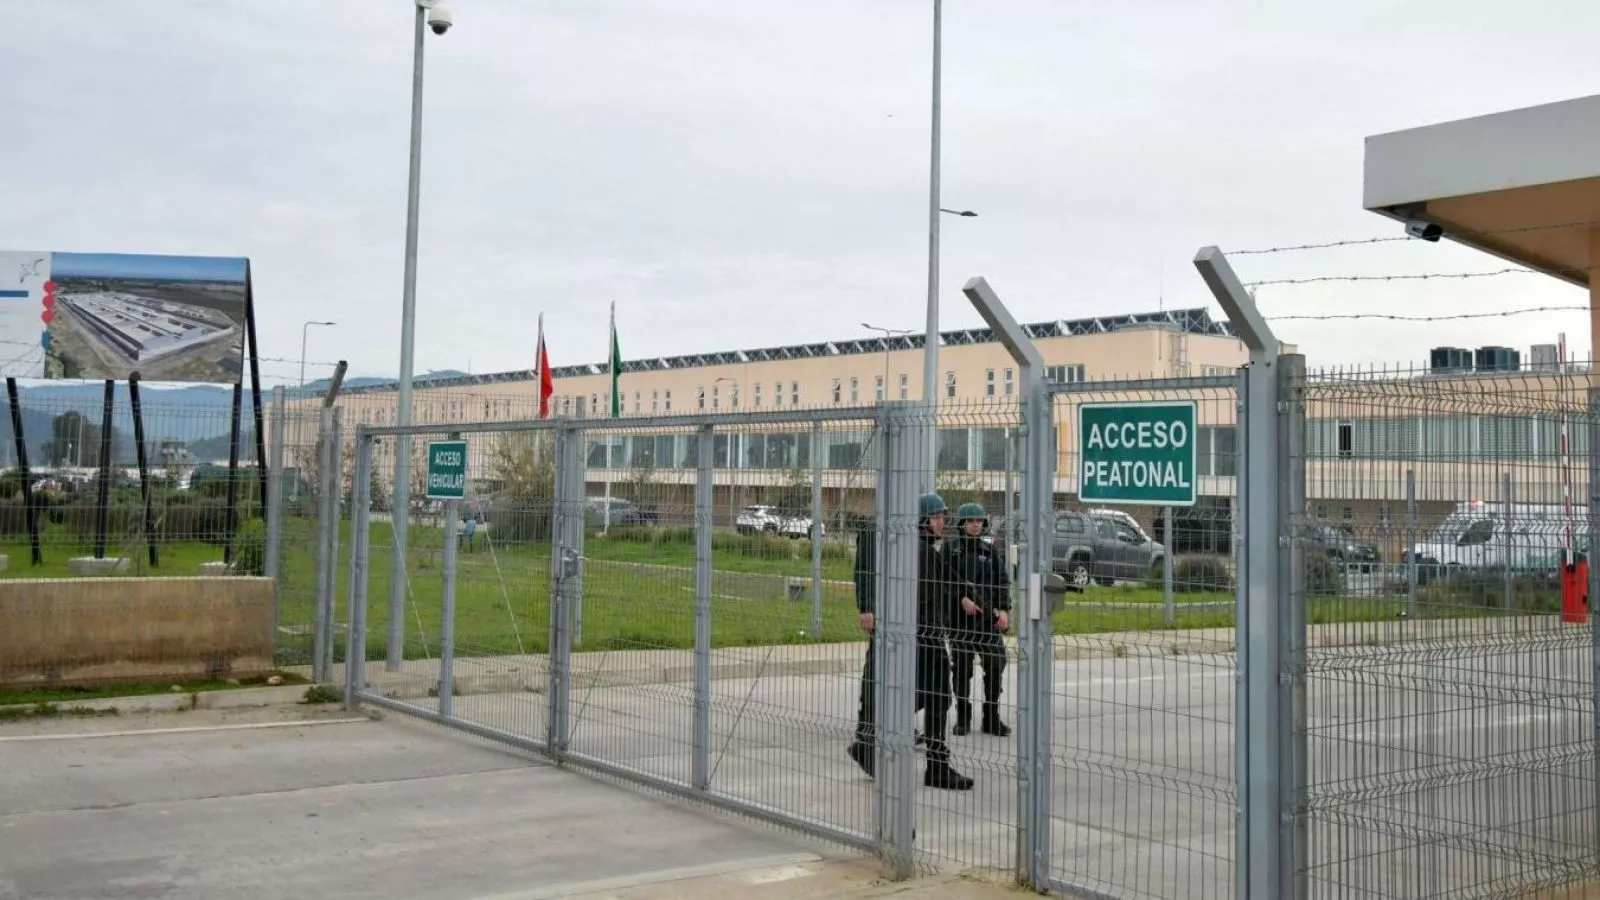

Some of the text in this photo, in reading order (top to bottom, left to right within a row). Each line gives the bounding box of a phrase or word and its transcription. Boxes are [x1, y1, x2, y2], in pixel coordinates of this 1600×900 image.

[1088, 420, 1187, 449] ACCESO
[435, 451, 461, 466] ACCESO
[429, 473, 464, 488] VEHICULAR
[1084, 461, 1190, 487] PEATONAL
